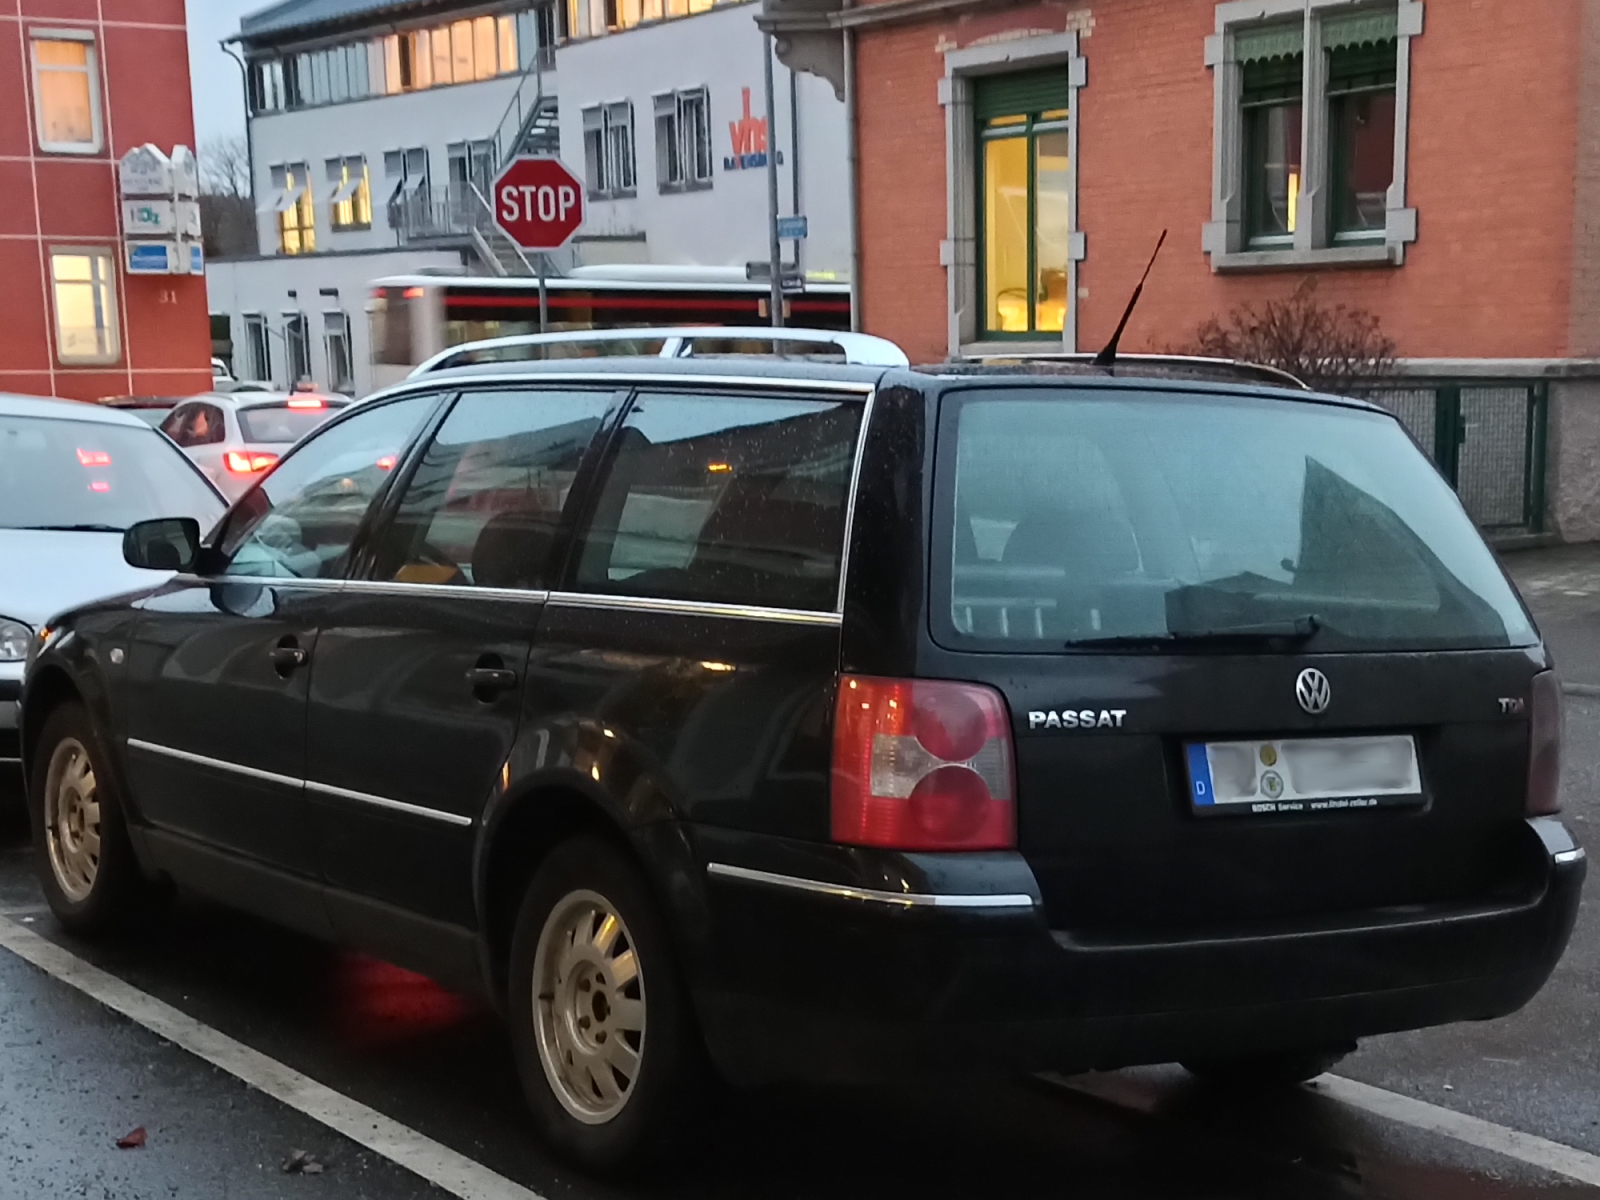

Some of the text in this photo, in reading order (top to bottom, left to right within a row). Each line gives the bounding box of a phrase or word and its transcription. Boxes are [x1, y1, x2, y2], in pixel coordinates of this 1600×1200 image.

[501, 185, 576, 222] STOP
[159, 290, 178, 304] 31
[1028, 709, 1127, 729] PASSAT
[1195, 781, 1206, 795] D
[1251, 803, 1276, 812] BOSCH
